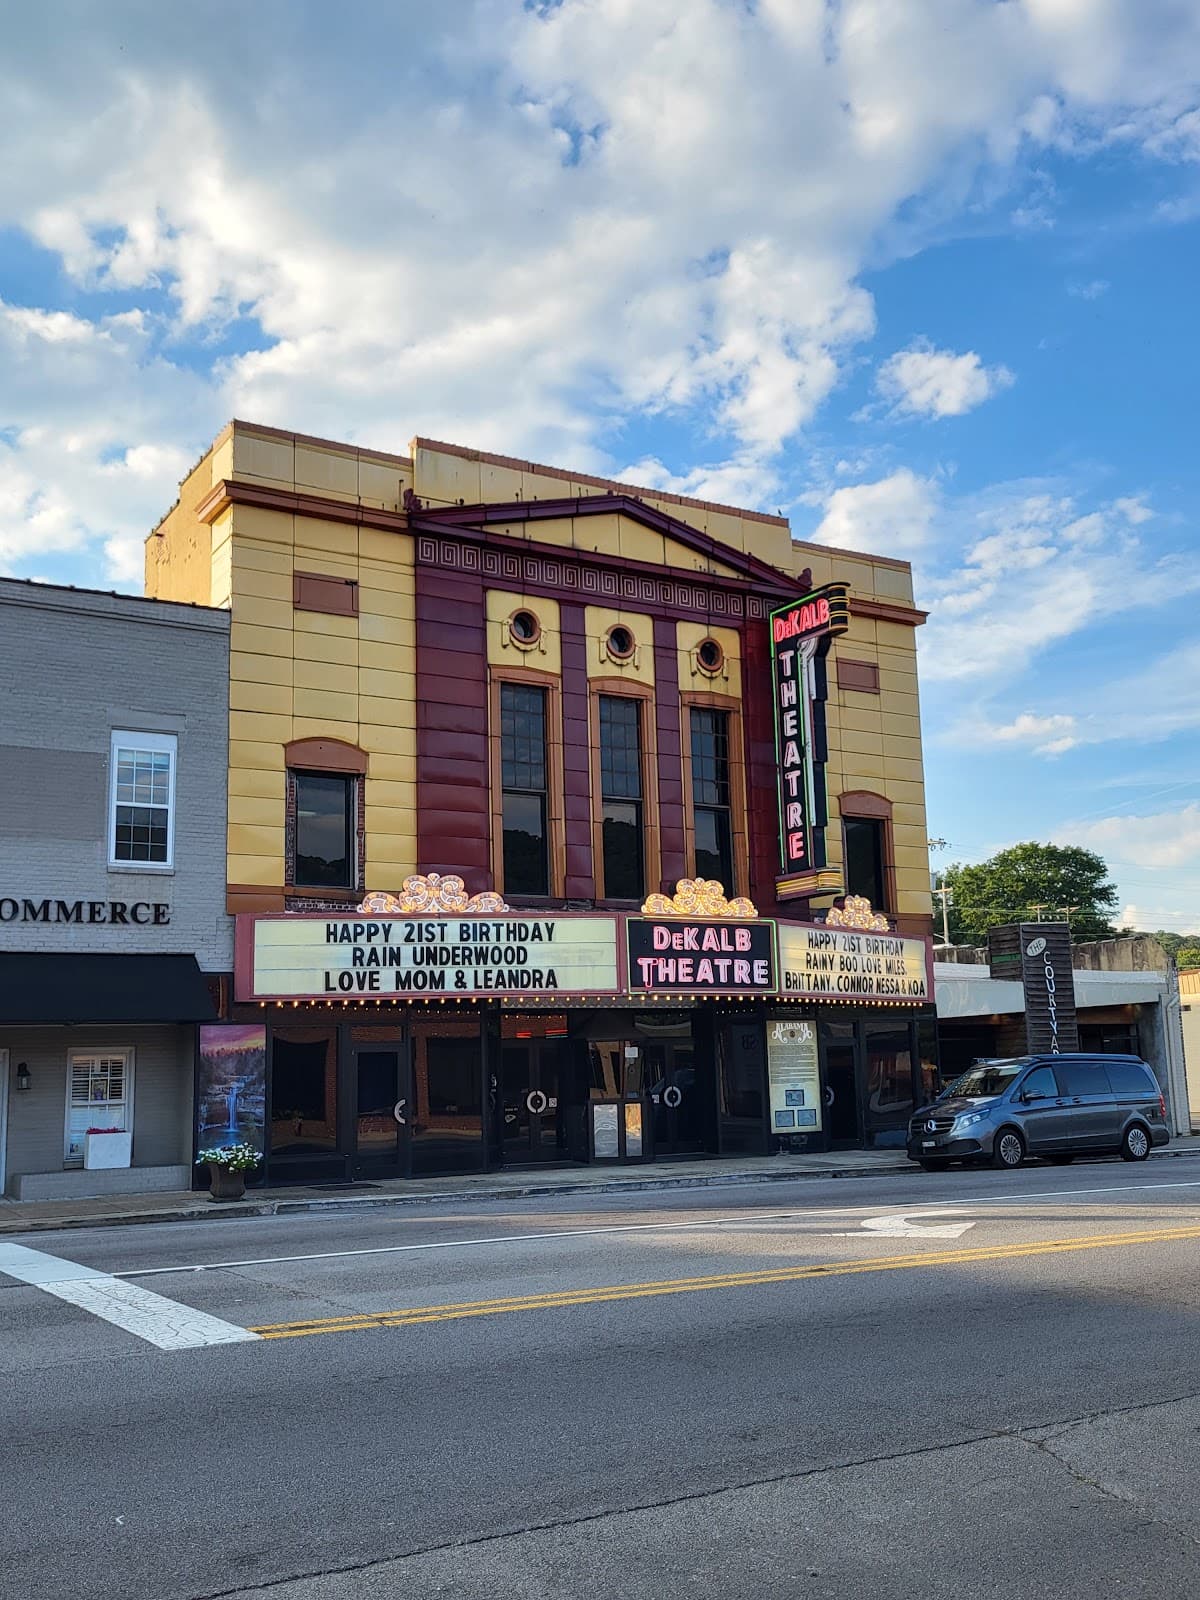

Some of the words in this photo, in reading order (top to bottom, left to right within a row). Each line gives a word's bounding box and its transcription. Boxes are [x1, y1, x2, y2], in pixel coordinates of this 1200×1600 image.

[779, 650, 805, 860] THEATRE
[0, 898, 170, 925] OMMERCE
[326, 922, 393, 943] HAPPY
[404, 922, 448, 943] 21ST
[459, 922, 555, 943] BIRTHDAY
[807, 931, 838, 951] HAPPY
[866, 938, 905, 957] BIRTHDAY
[352, 946, 401, 967] RAIN
[412, 945, 528, 966] UNDERWOOD
[1029, 940, 1044, 954] THE
[637, 957, 769, 987] THEATRE
[806, 952, 835, 971] RAINY
[840, 955, 858, 973] BOO
[861, 958, 882, 975] LOVE
[325, 970, 380, 991] LOVE
[395, 970, 445, 990] MOM
[454, 969, 468, 990] &
[473, 968, 558, 989] LEANDRA
[837, 975, 874, 993] CONNOR
[876, 977, 901, 995] NESSA
[908, 980, 926, 996] KOA
[772, 1022, 814, 1044] ALABAMA
